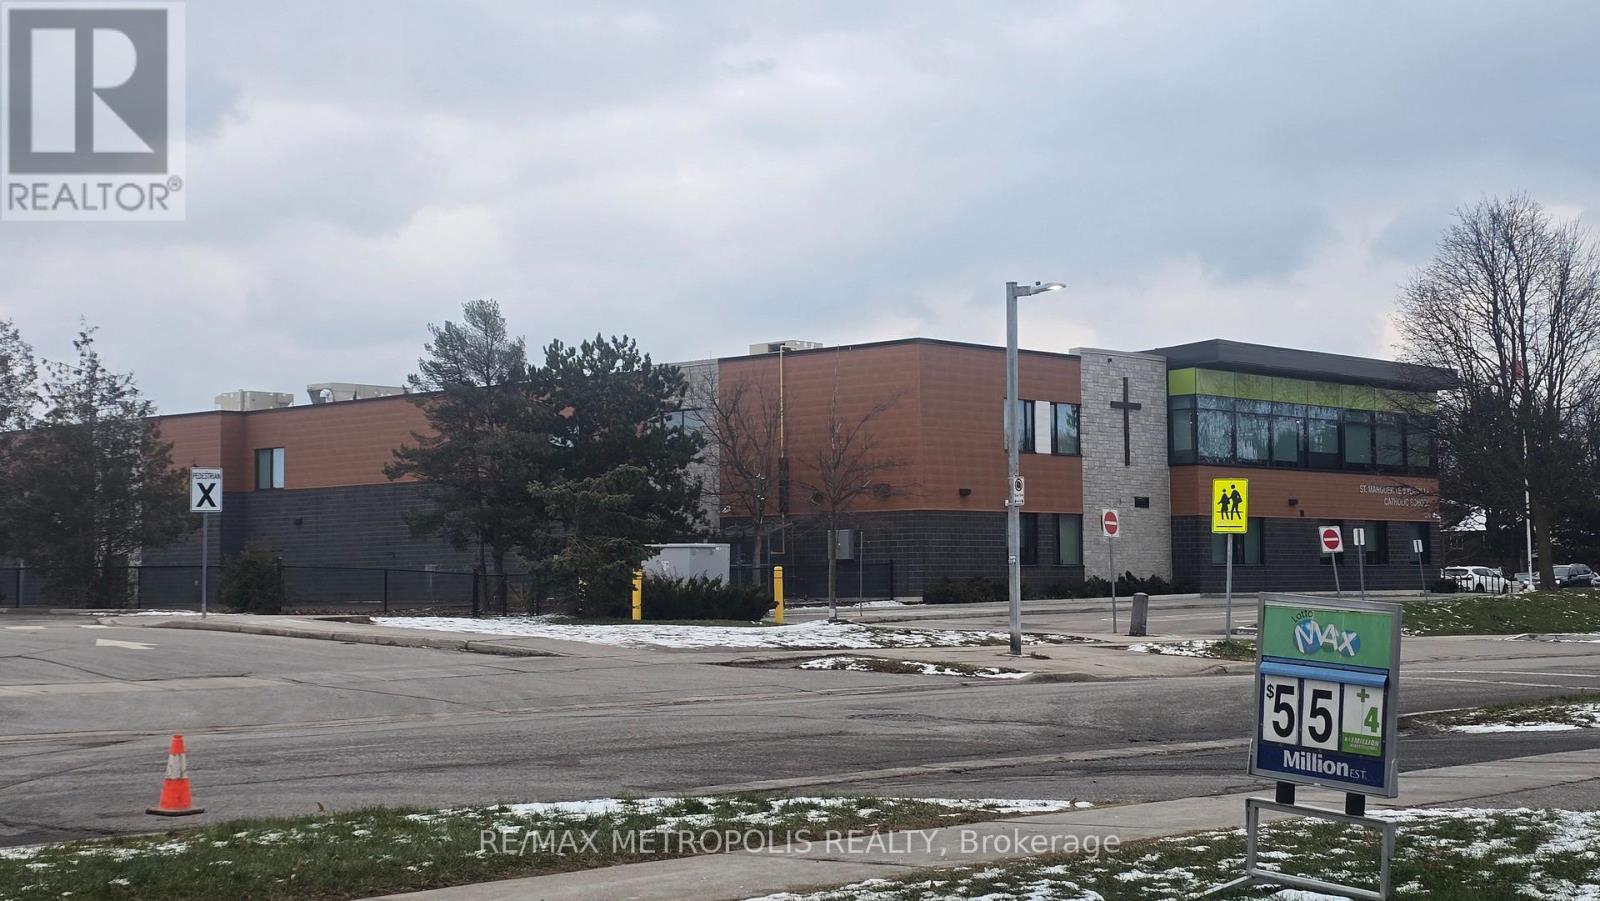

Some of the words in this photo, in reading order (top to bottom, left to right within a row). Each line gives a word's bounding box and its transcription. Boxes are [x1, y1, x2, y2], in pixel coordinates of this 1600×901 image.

[196, 482, 217, 508] X
[1383, 497, 1409, 507] CATHOLIC
[1291, 609, 1314, 624] Lotto
[1363, 706, 1380, 733] 4
[1283, 749, 1349, 777] Million
